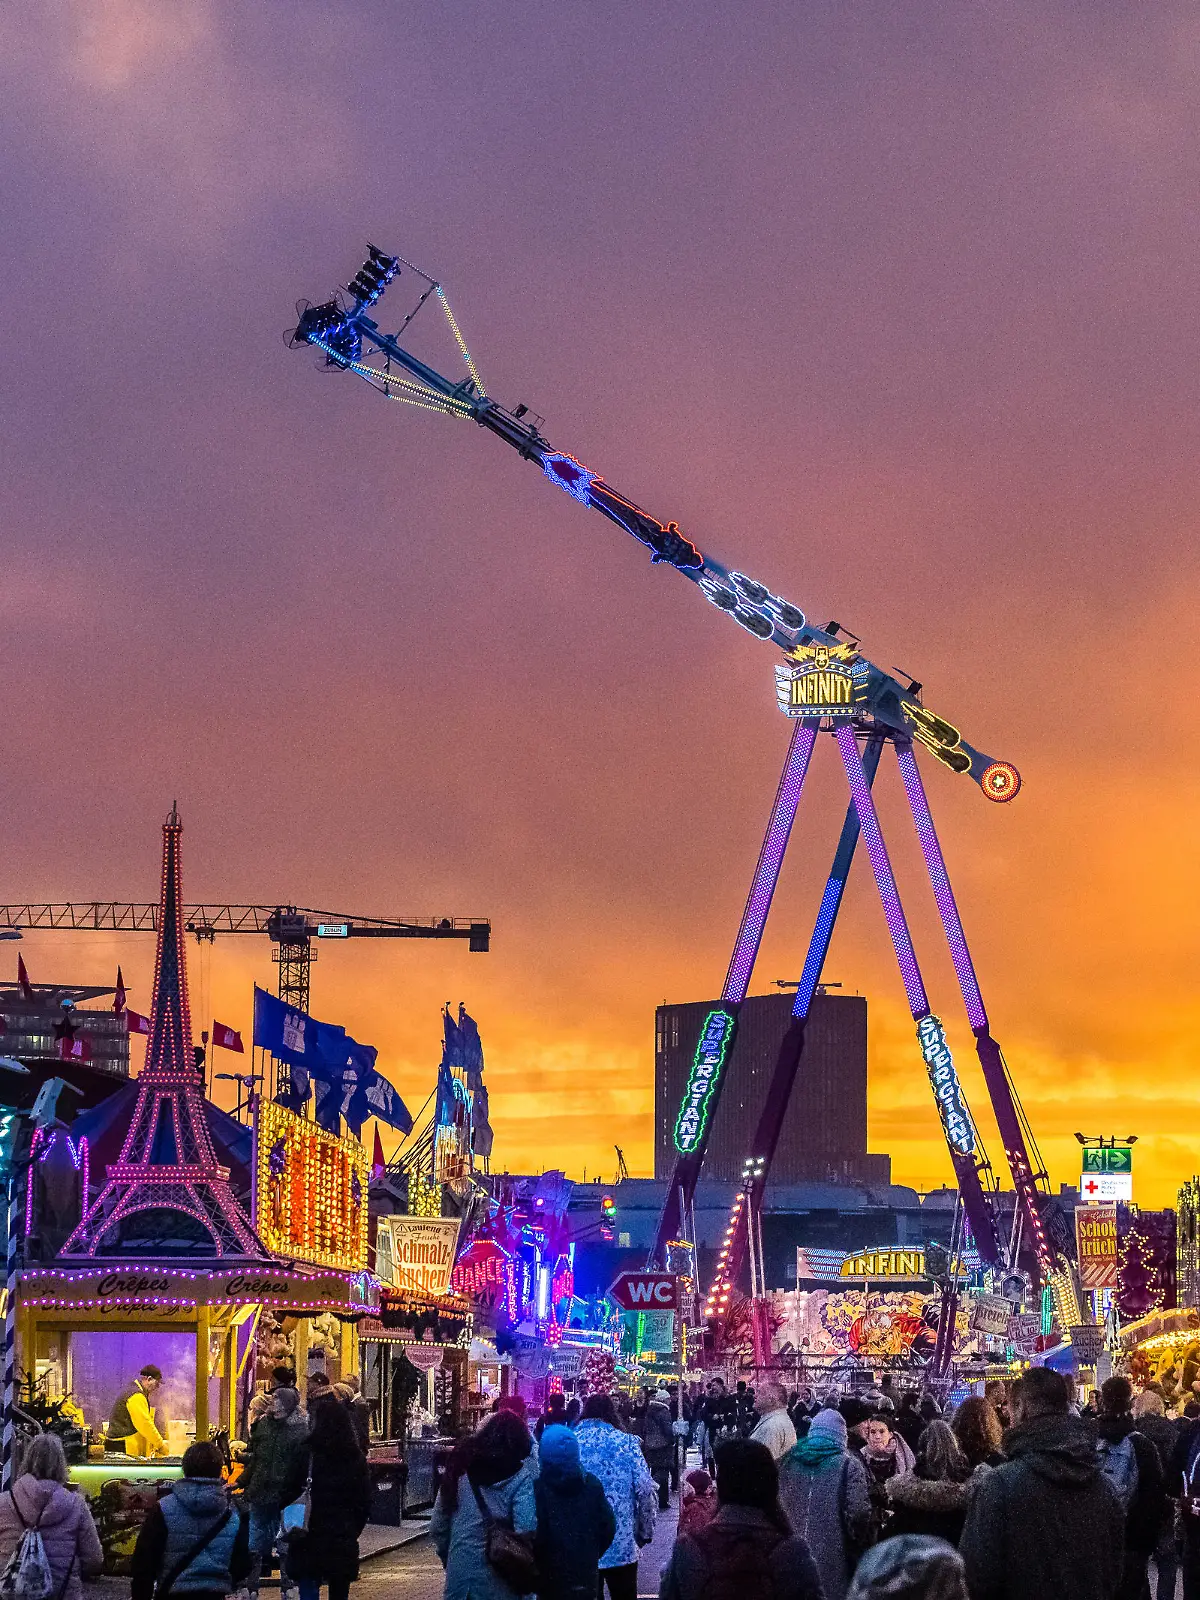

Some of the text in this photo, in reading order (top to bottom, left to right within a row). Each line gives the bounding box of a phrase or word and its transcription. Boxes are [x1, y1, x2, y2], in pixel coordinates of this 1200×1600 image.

[792, 672, 853, 705] INFINITY
[97, 1273, 171, 1297] Crêpes
[225, 1275, 290, 1297] Crêpes
[397, 1264, 447, 1291] kuchen
[627, 1281, 673, 1303] WC
